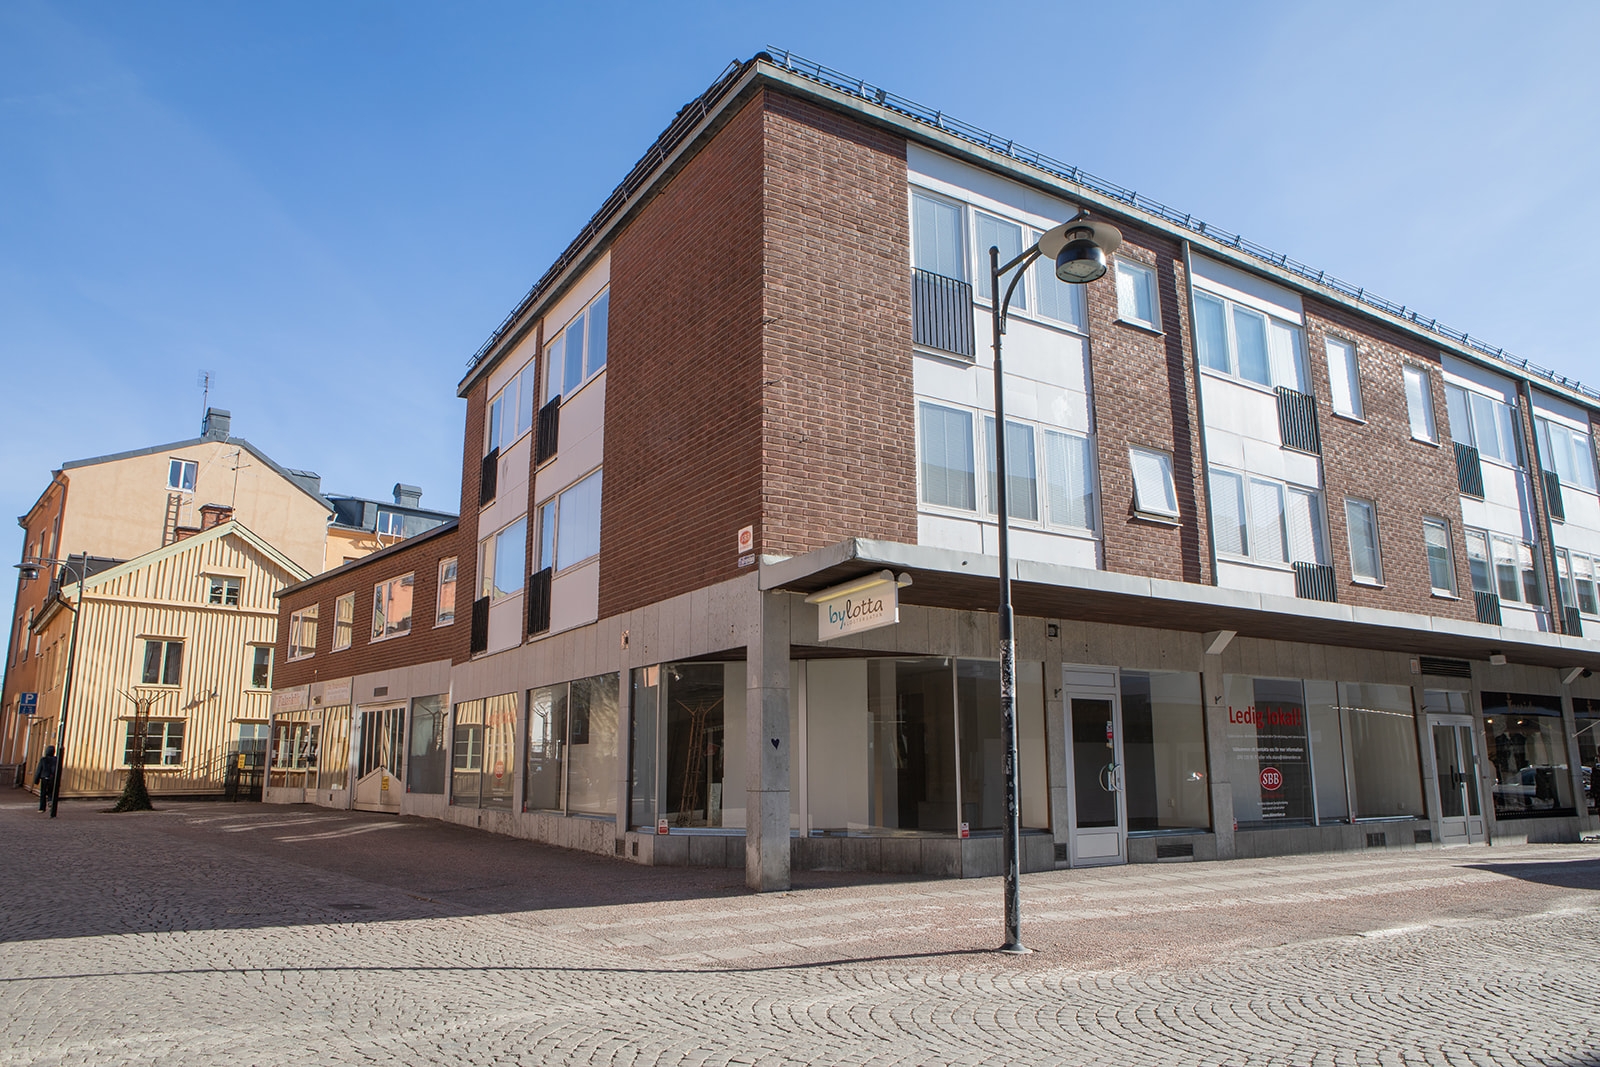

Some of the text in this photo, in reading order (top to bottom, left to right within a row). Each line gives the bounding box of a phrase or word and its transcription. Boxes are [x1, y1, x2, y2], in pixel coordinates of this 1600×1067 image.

[829, 598, 883, 630] bylotta
[25, 693, 34, 704] P
[1228, 705, 1301, 729] Ledig lokal!
[1262, 772, 1280, 785] SBB
